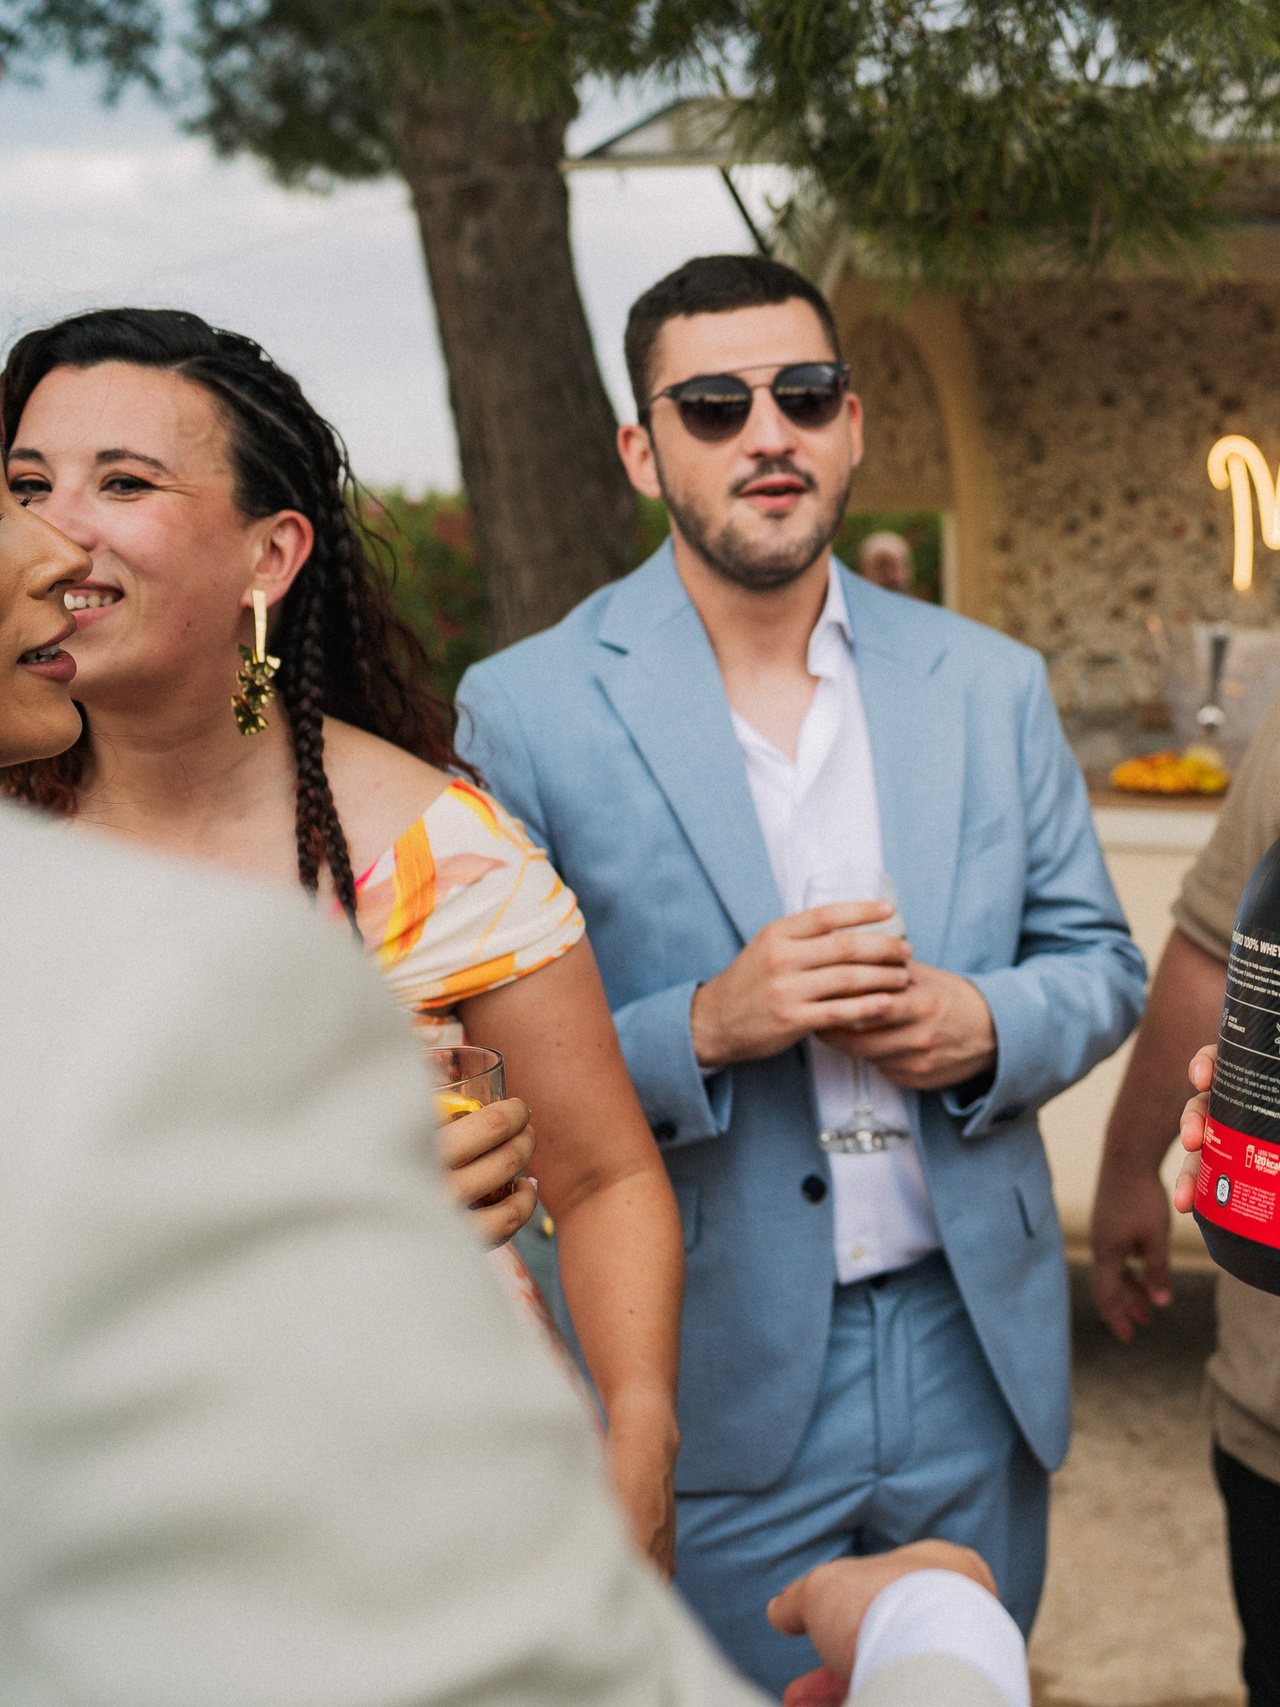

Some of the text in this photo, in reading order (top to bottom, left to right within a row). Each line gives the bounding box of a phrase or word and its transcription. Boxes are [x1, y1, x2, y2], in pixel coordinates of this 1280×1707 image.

[1244, 935, 1259, 951] 100%
[1259, 964, 1273, 973] support
[1254, 1153, 1267, 1165] 120
